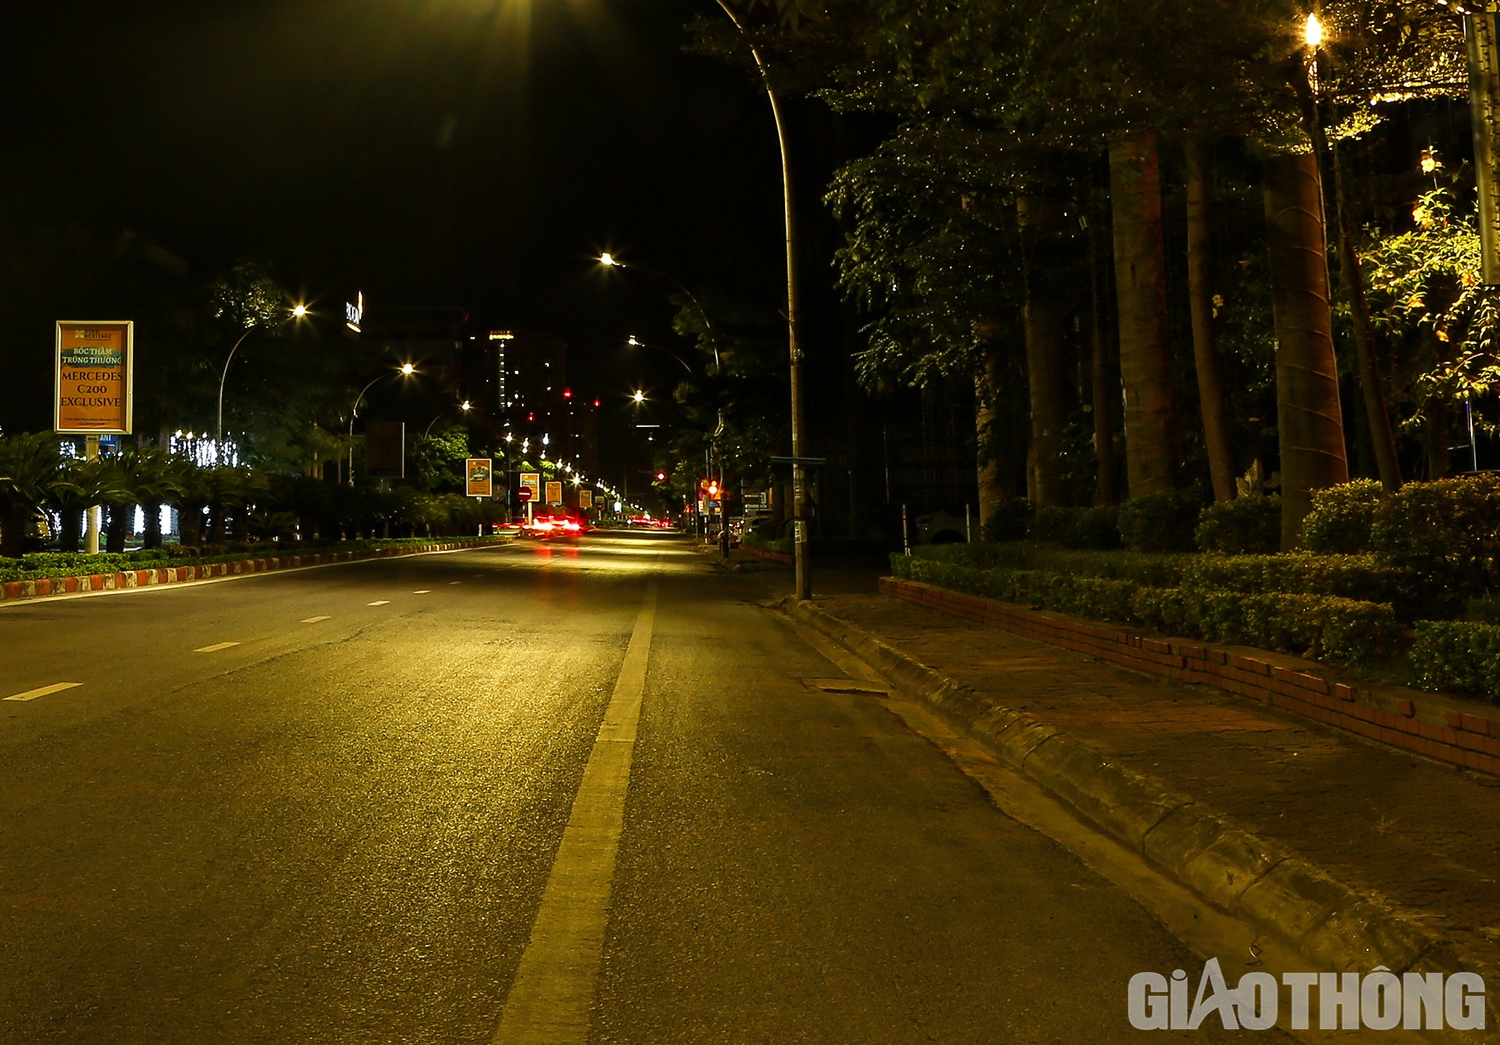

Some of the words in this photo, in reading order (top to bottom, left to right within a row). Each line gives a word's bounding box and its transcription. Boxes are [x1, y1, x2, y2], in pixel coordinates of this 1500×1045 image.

[62, 371, 123, 381] MERCEDES
[77, 384, 107, 393] C200
[61, 397, 120, 406] EXCLUSIVE
